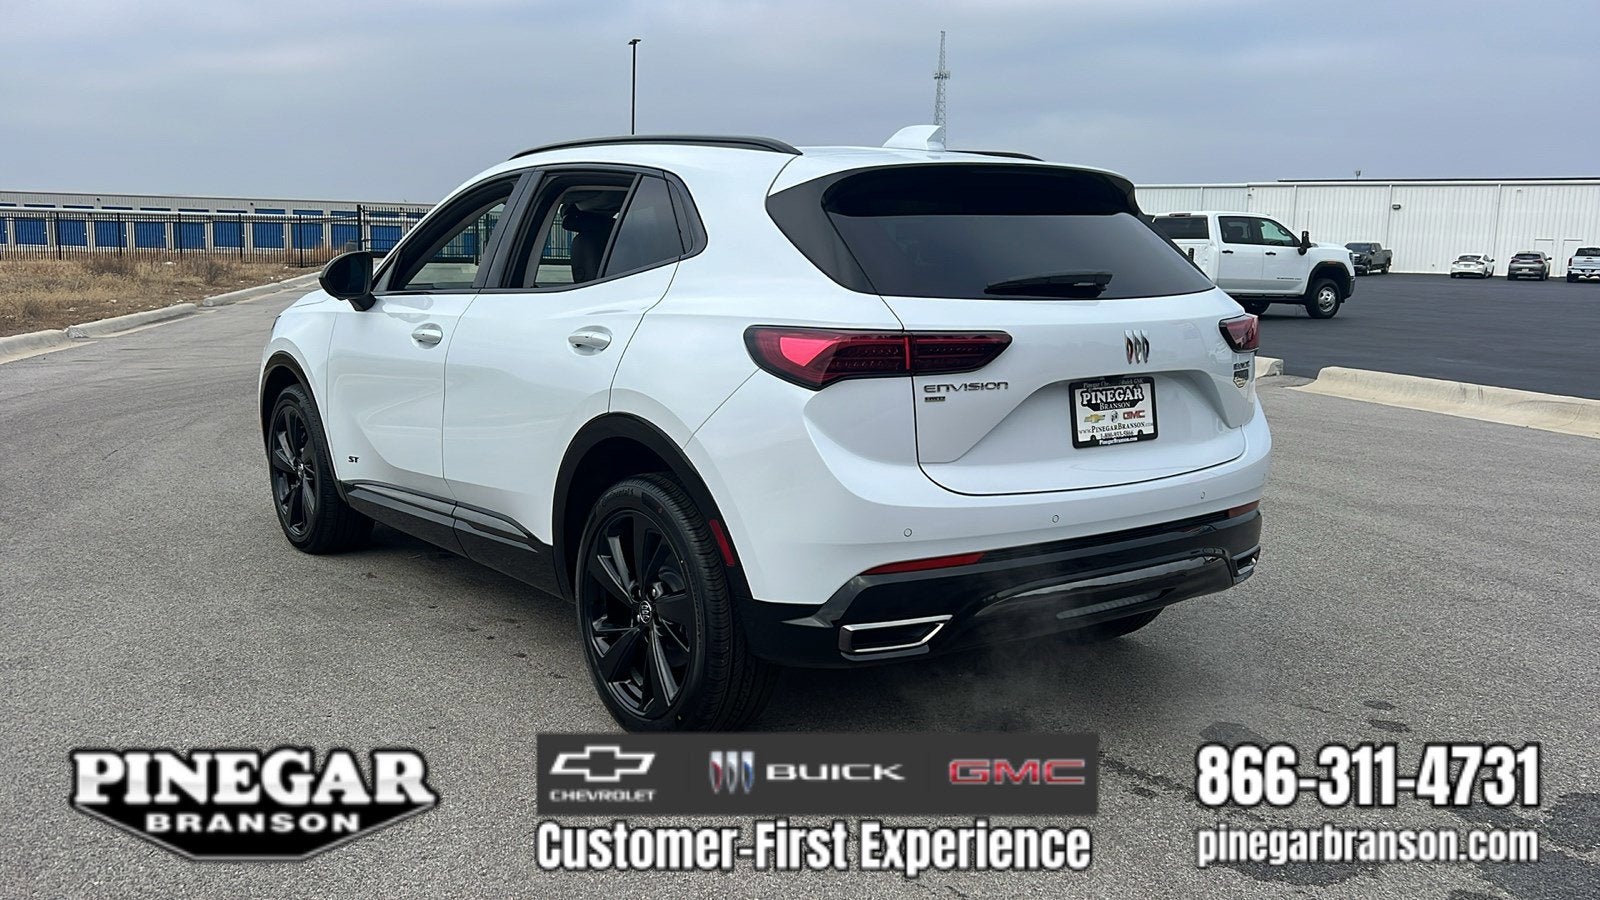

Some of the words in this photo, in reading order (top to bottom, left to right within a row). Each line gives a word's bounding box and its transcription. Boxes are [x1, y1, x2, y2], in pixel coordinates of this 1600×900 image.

[923, 381, 1009, 393] ENVISION
[1081, 387, 1143, 404] PINEGAR
[1099, 400, 1131, 410] BRANSON
[1123, 410, 1145, 420] GMC
[348, 455, 360, 463] ST
